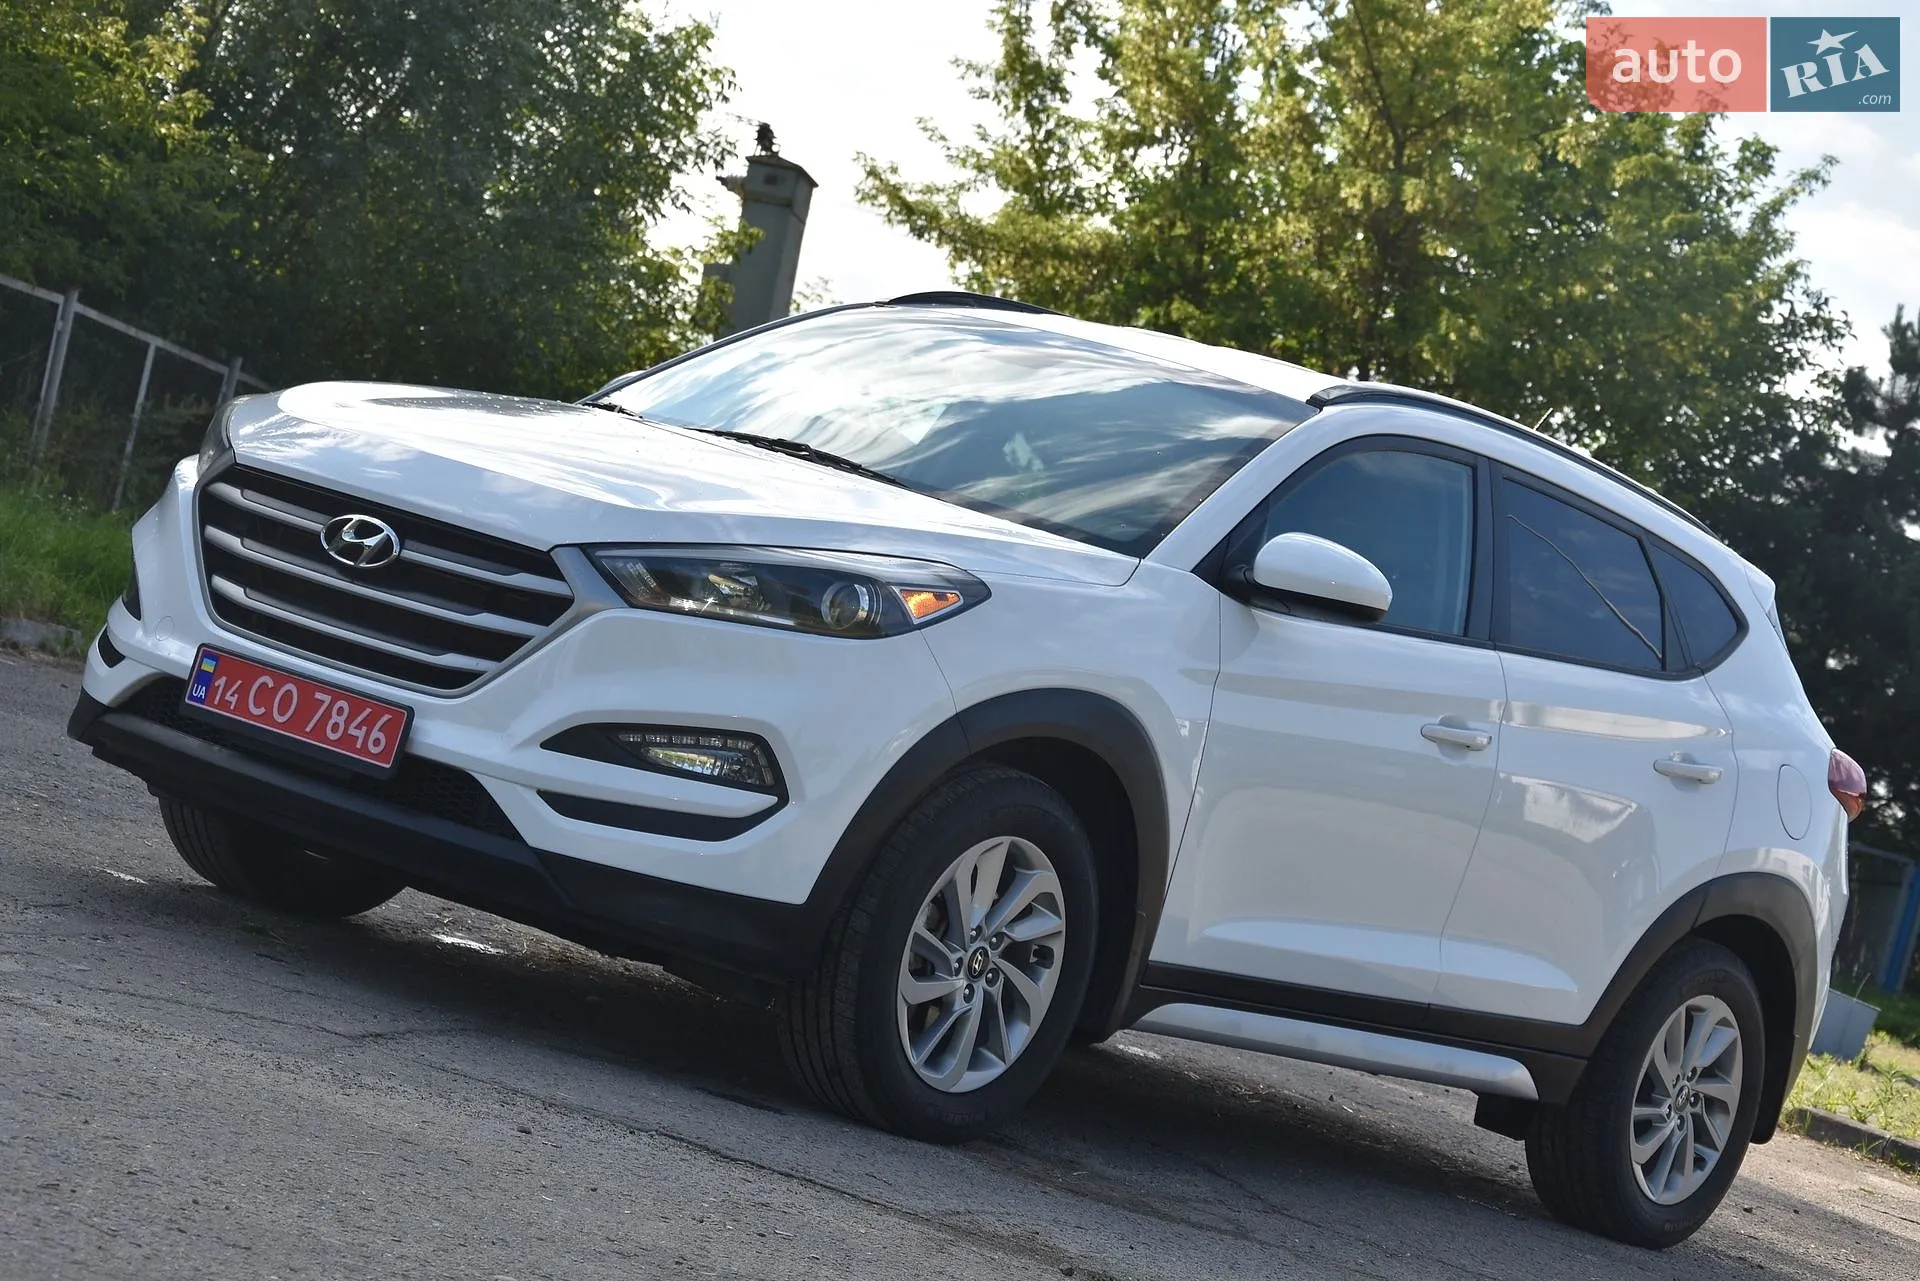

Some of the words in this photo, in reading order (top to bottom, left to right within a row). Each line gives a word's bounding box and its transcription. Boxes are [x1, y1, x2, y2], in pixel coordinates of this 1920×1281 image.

[192, 683, 206, 699] UA
[214, 676, 243, 710] 14
[248, 675, 298, 724] CO
[305, 692, 392, 754] 7846
